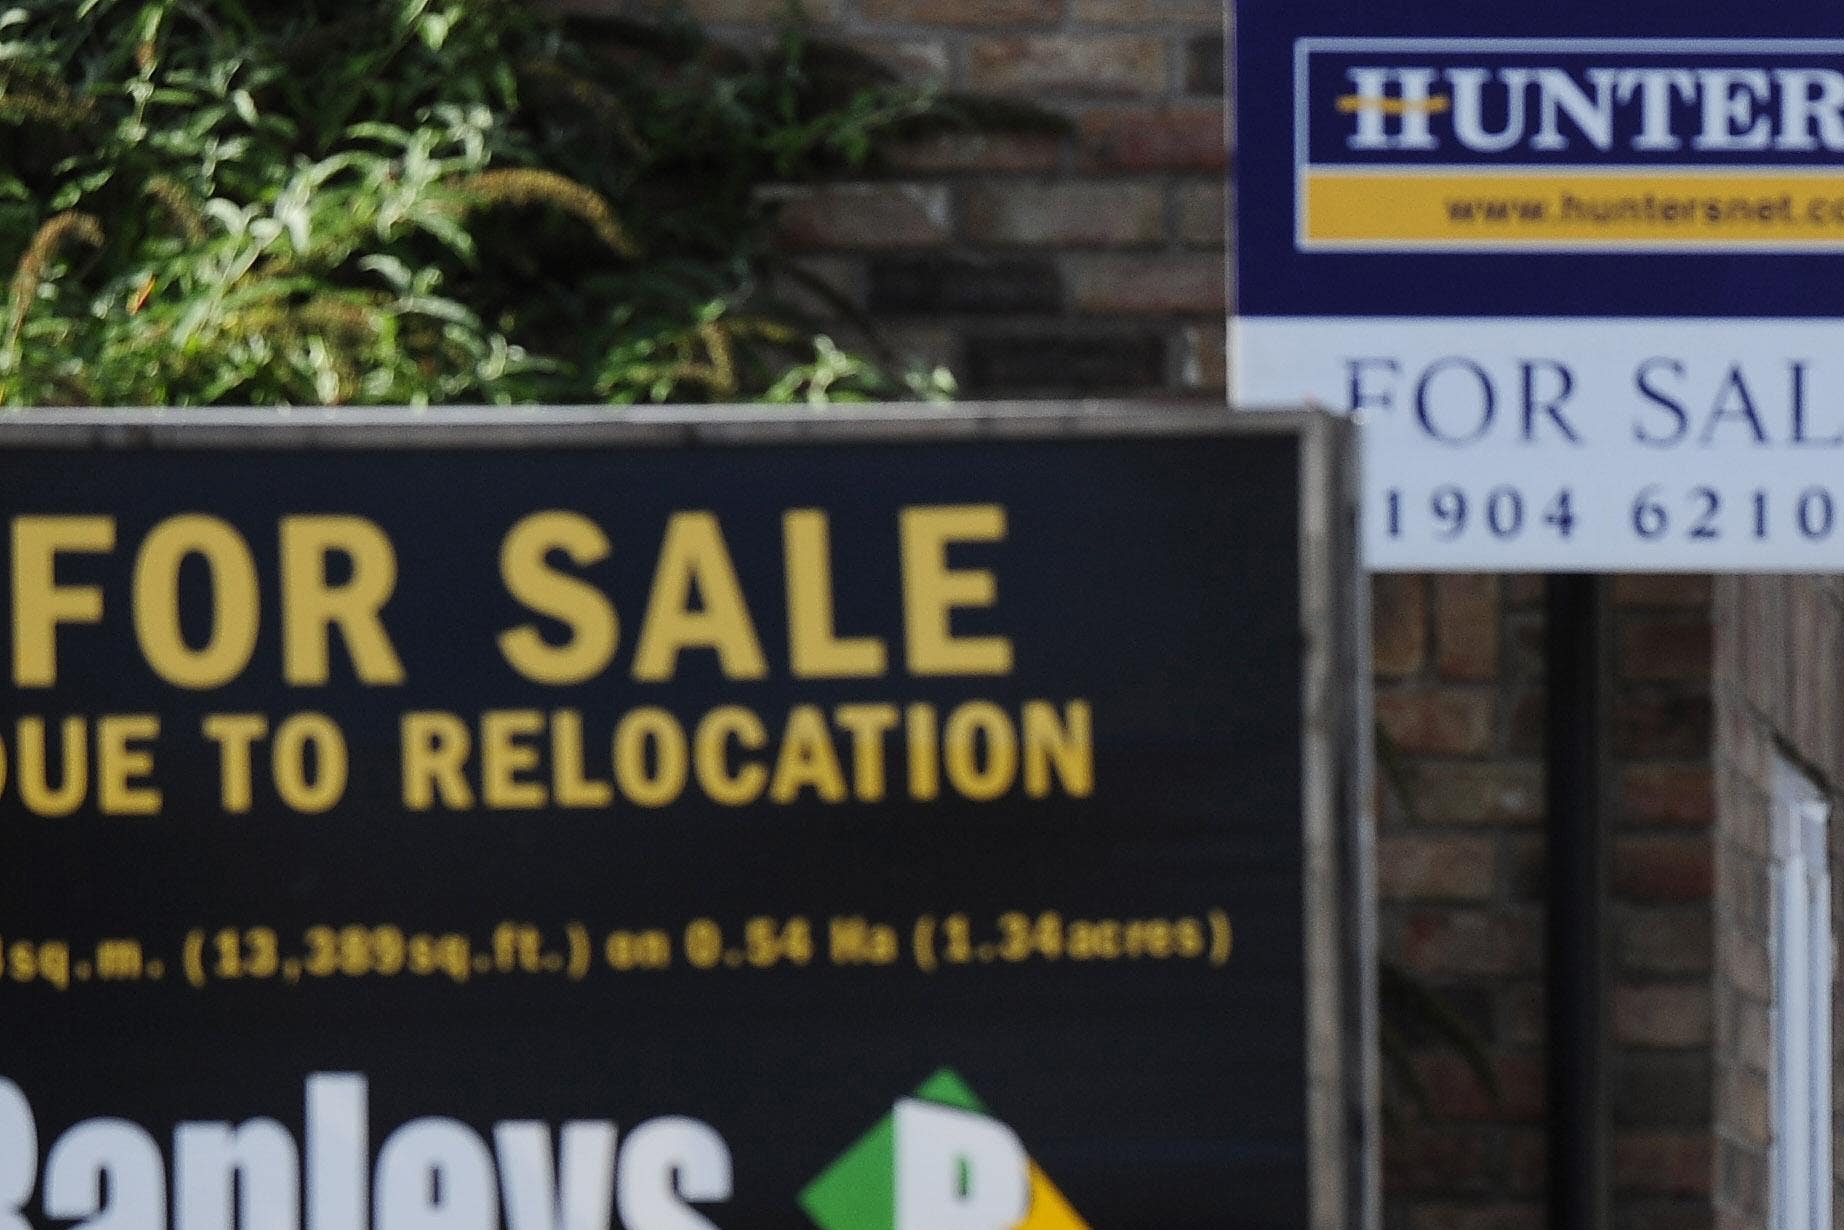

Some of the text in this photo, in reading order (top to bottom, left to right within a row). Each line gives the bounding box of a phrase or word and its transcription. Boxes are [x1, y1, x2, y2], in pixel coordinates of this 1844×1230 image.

[1345, 356, 1588, 447] FOR
[1385, 487, 1577, 541] 1904
[10, 505, 1013, 690] FOR SALE
[0, 700, 1092, 818] UE TO RELOCATION
[0, 936, 165, 991] sq.m.
[684, 915, 812, 969] 0.54
